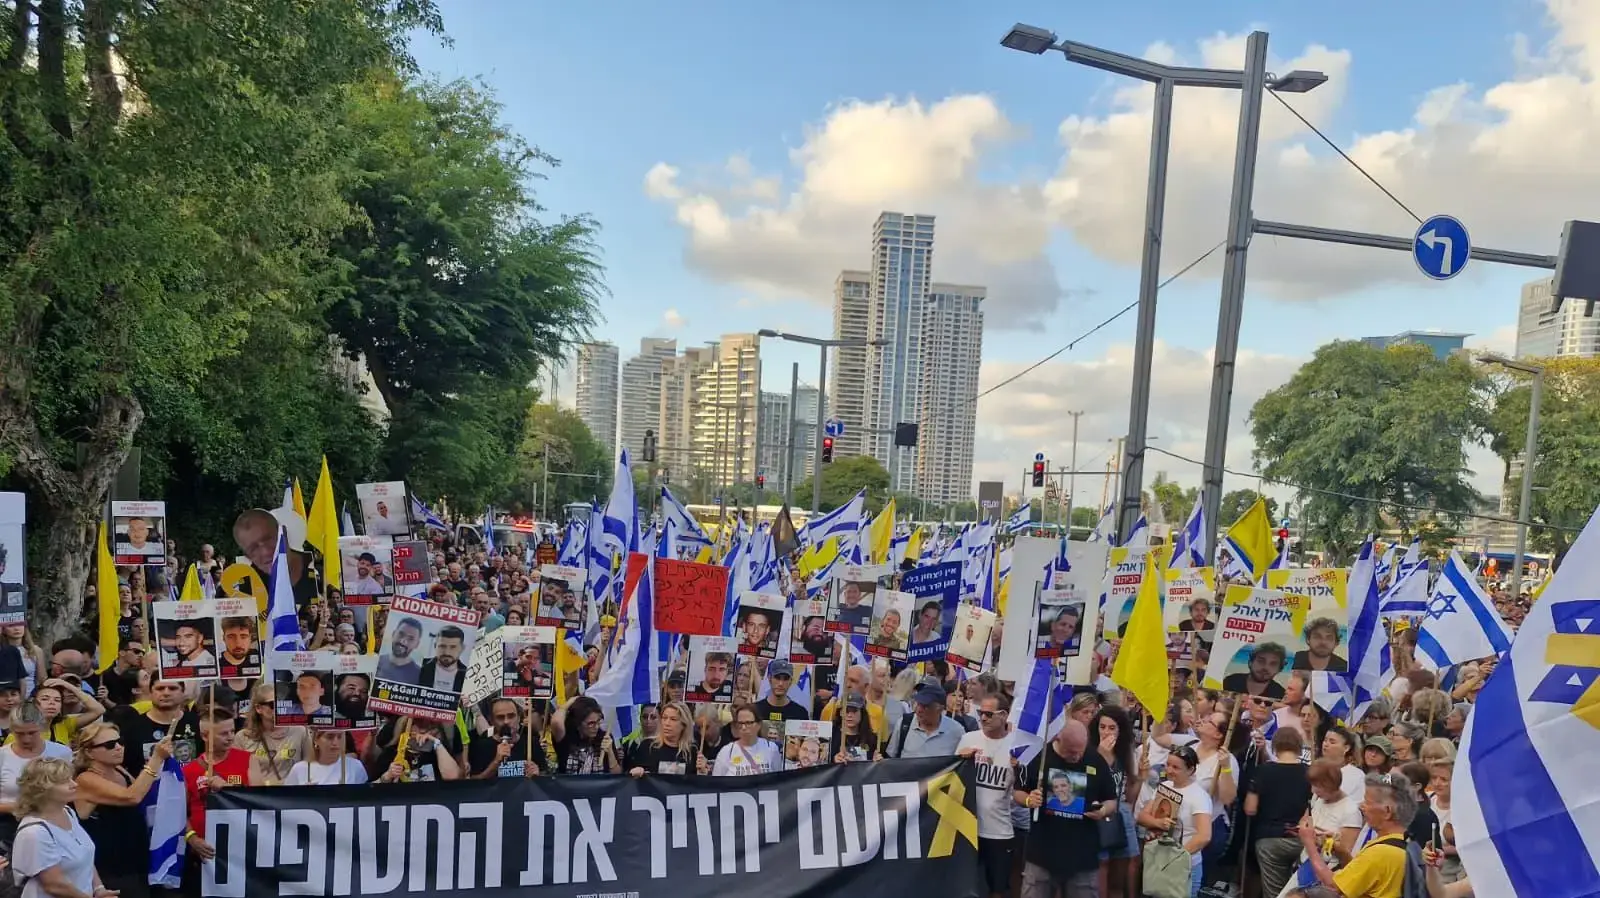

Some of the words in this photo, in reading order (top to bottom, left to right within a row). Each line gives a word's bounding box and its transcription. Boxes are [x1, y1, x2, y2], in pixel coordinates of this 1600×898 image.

[944, 567, 957, 577] אין
[1116, 562, 1137, 572] אהל
[906, 575, 919, 583] בלי
[921, 570, 943, 581] ניצחון
[1115, 575, 1140, 584] הביתה
[1188, 578, 1204, 586] אלון
[1112, 587, 1137, 595] בחיים
[1306, 585, 1334, 596] אלון
[1254, 596, 1268, 604] את
[394, 597, 477, 624] KIDNAPPED
[1232, 601, 1261, 617] אהל
[1264, 607, 1293, 621] אלון
[1227, 618, 1262, 631] הביתה
[1222, 631, 1256, 643] בחיים
[378, 681, 418, 695] Ziv&Gali
[420, 689, 455, 702] Berman
[390, 693, 409, 703] years
[411, 695, 423, 704] old
[370, 701, 393, 711] BRING
[394, 705, 414, 715] THEM
[414, 708, 435, 718] HOME
[436, 712, 455, 721] NOW!
[797, 781, 922, 870] העם
[631, 790, 781, 878] יחזיר
[520, 798, 618, 886] את
[201, 801, 504, 898] החטופים
